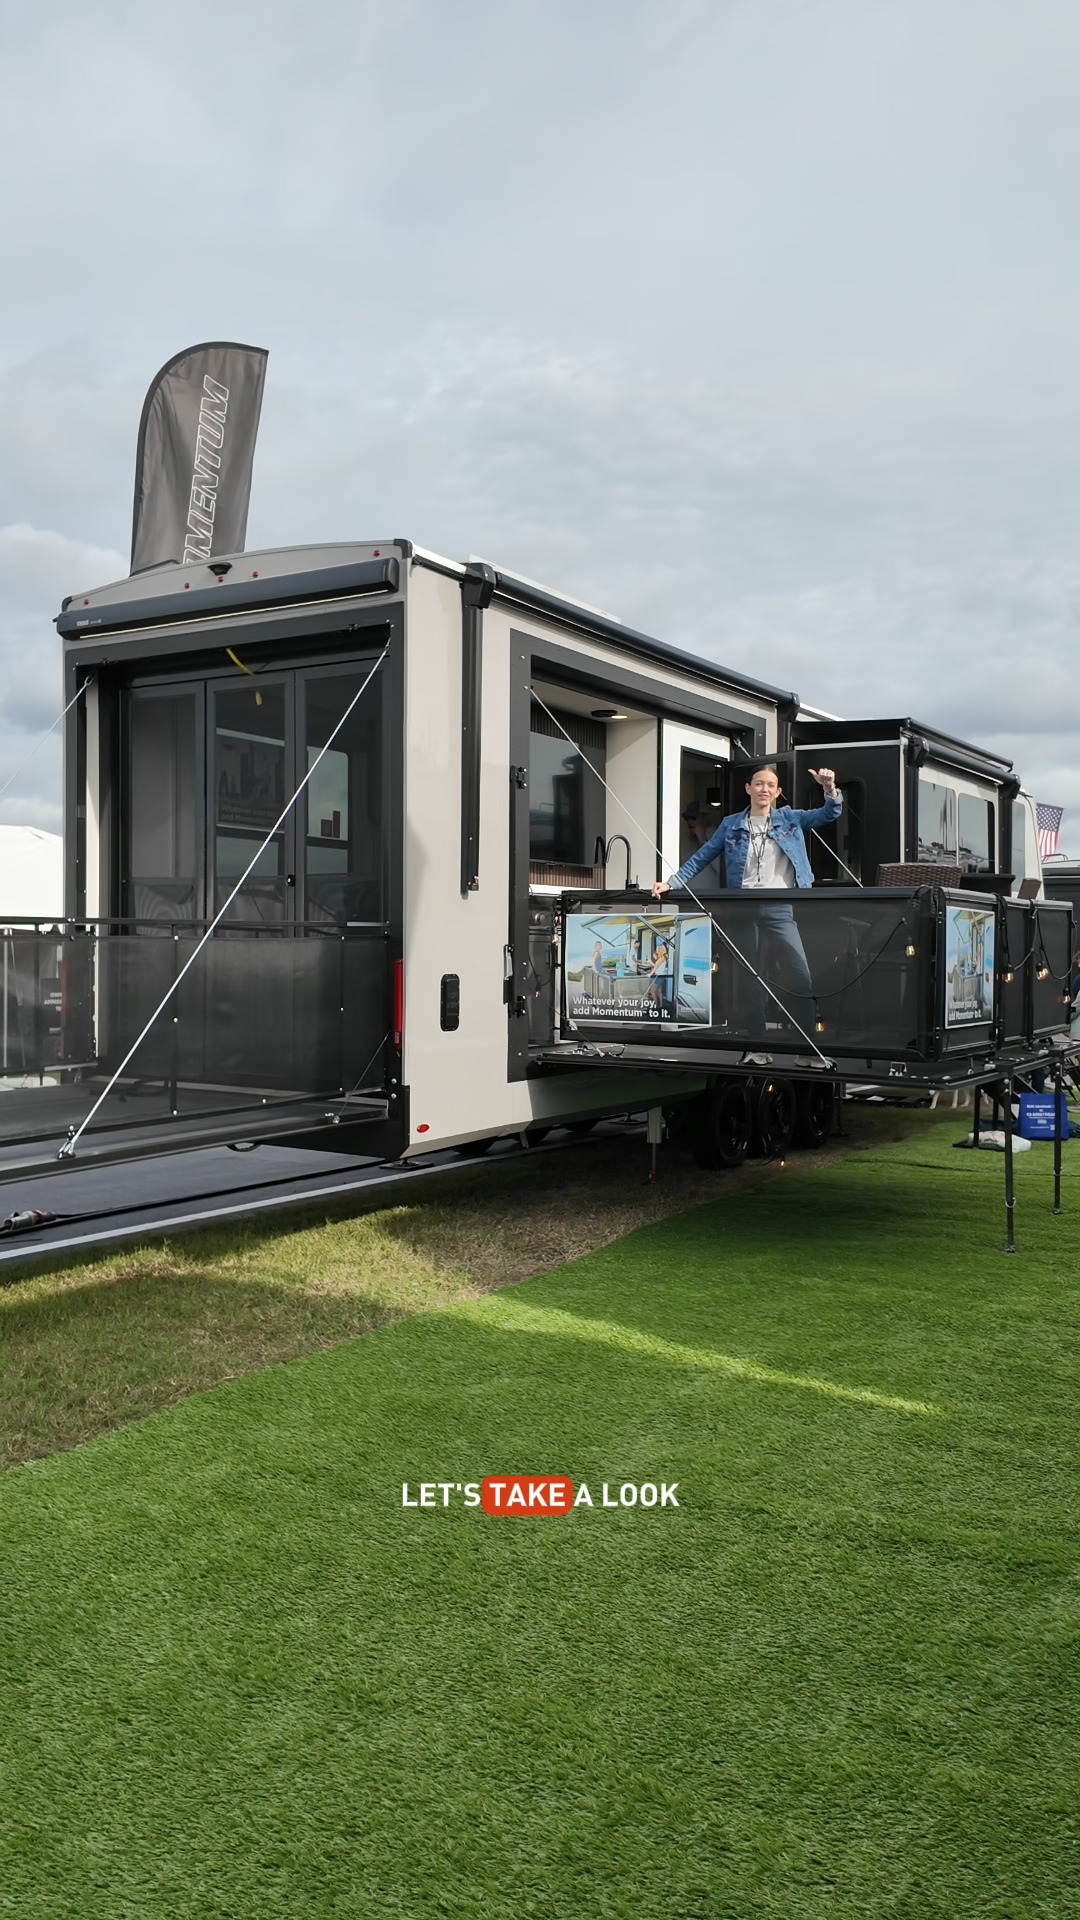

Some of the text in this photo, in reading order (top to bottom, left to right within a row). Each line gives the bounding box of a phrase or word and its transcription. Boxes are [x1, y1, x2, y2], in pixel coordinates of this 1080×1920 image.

[572, 997, 657, 1009] Whatever your joy,
[572, 1007, 590, 1015] add
[648, 1009, 659, 1018] to
[661, 1009, 671, 1018] it.
